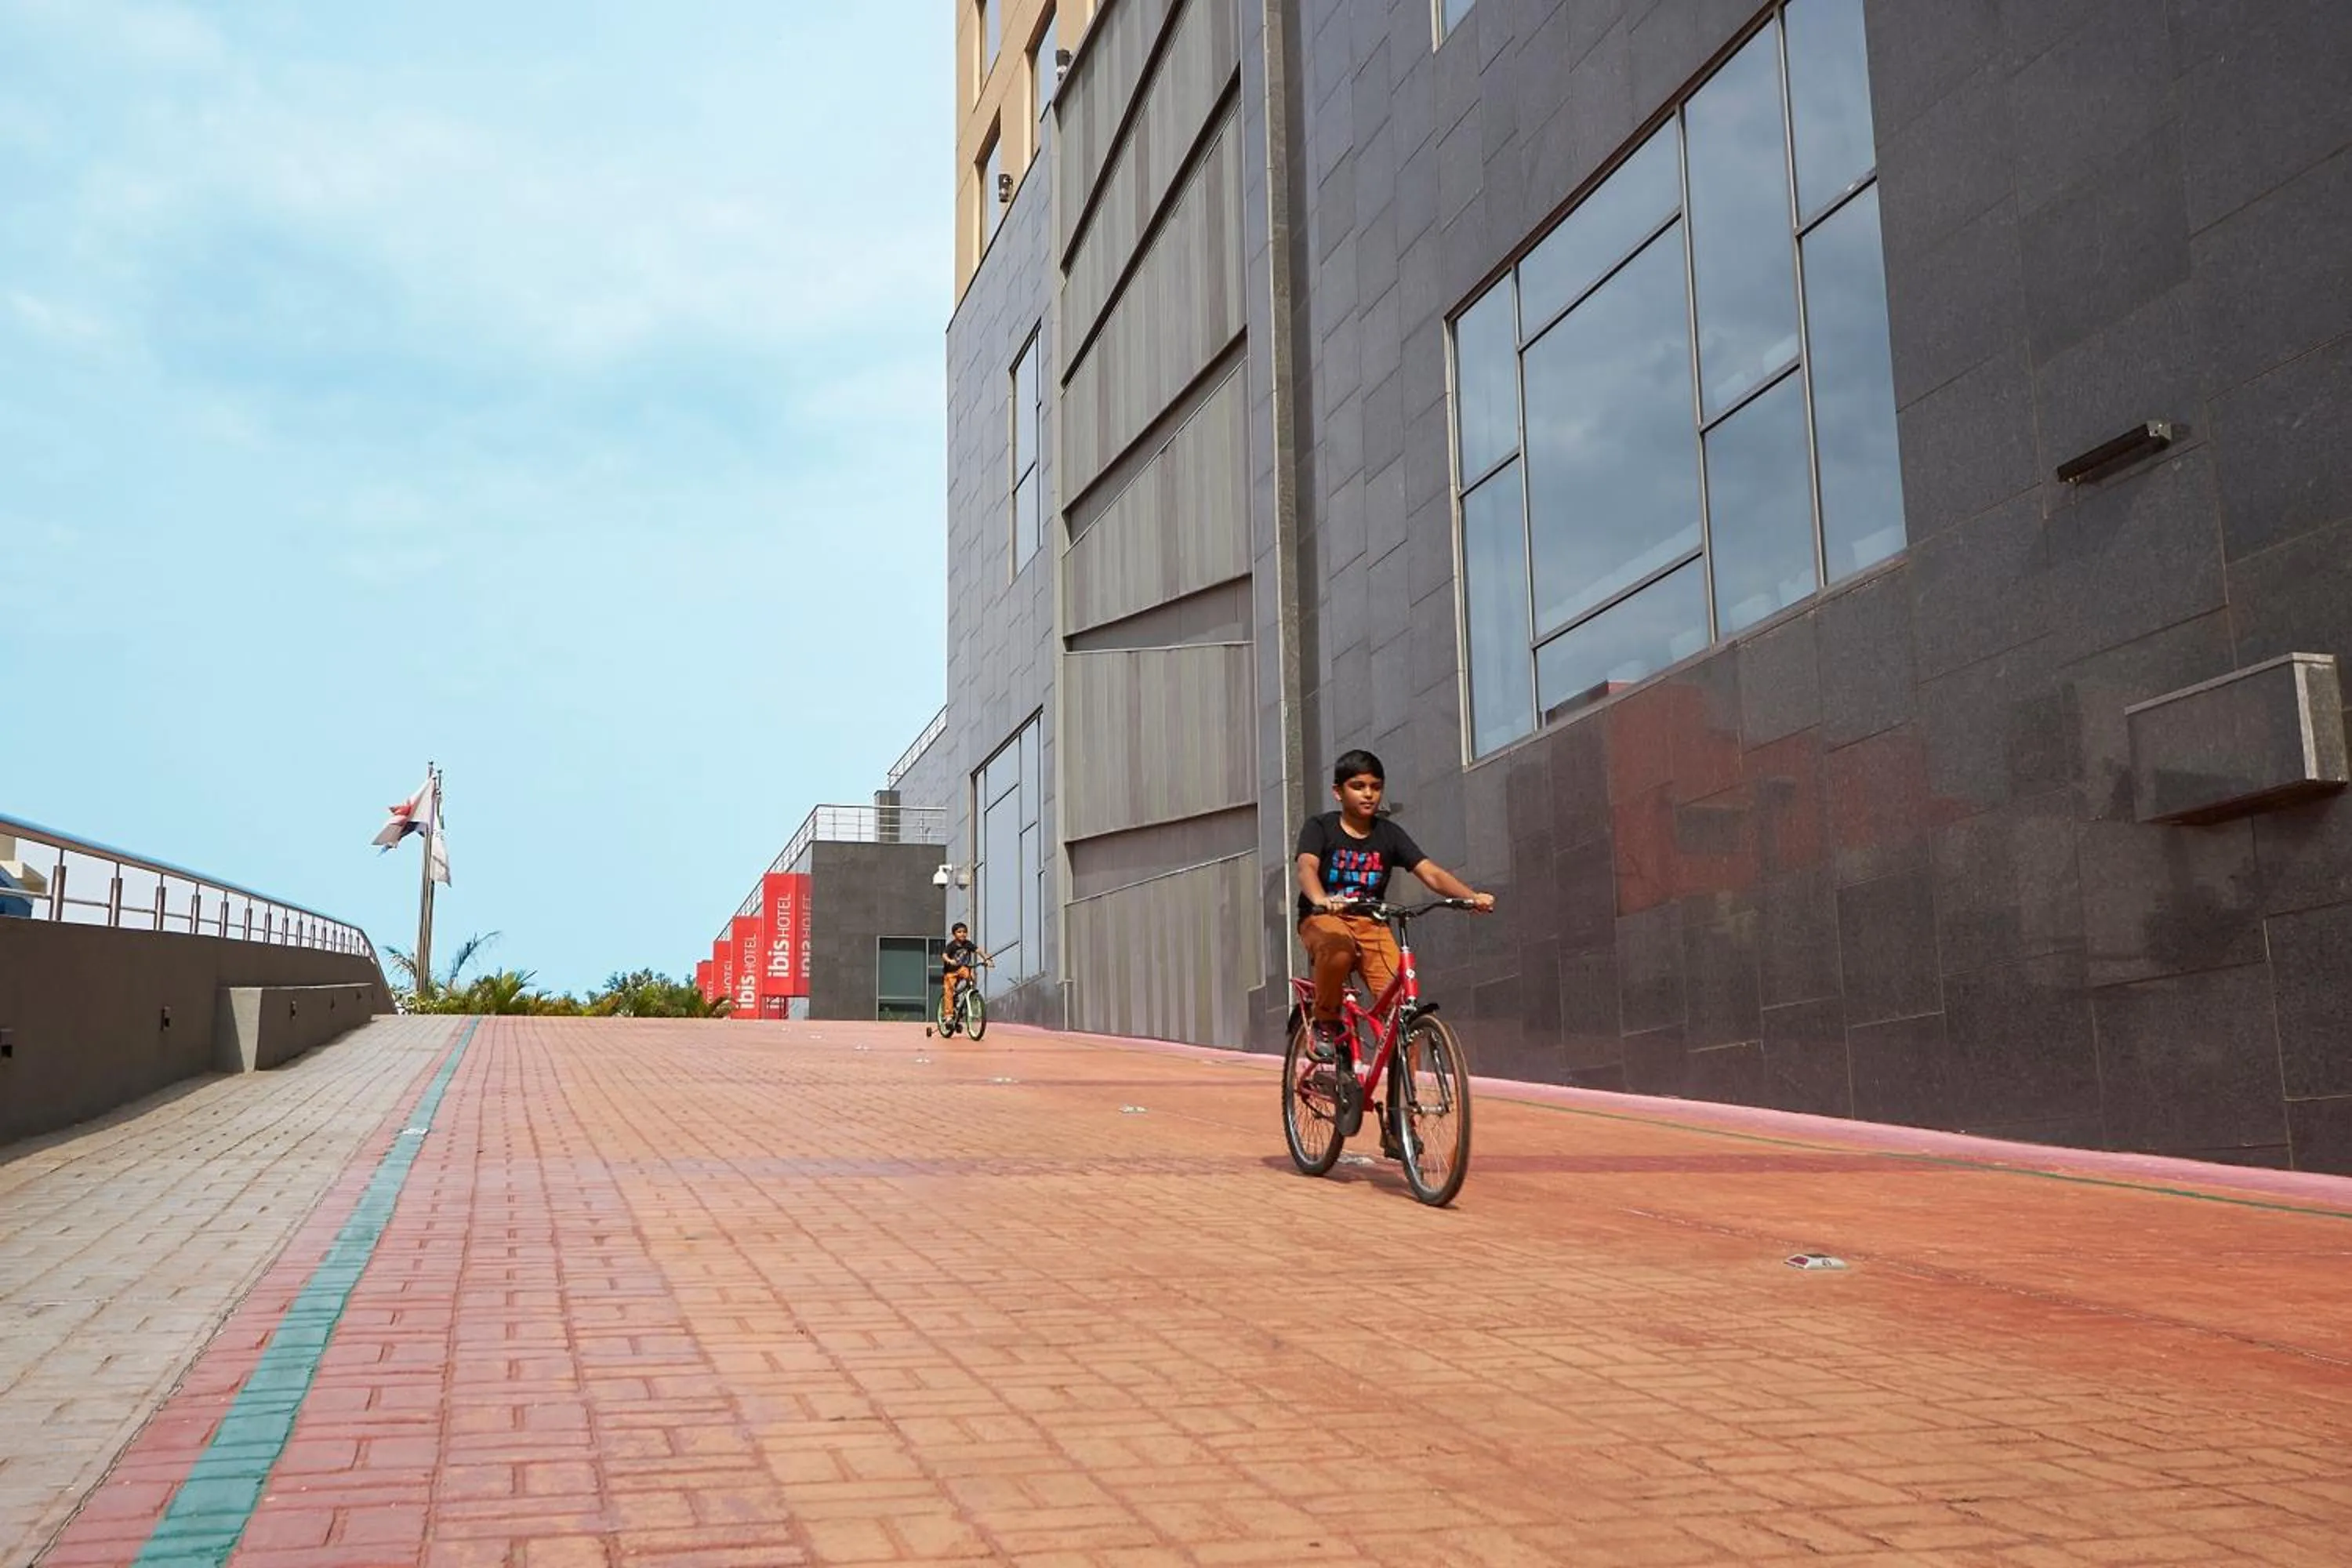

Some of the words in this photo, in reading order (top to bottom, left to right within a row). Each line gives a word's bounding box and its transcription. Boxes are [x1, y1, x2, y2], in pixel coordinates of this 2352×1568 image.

[777, 893, 791, 937] HOTEL
[744, 934, 757, 973] HOTEL
[767, 940, 789, 978] ibis
[735, 975, 756, 1009] ibis
